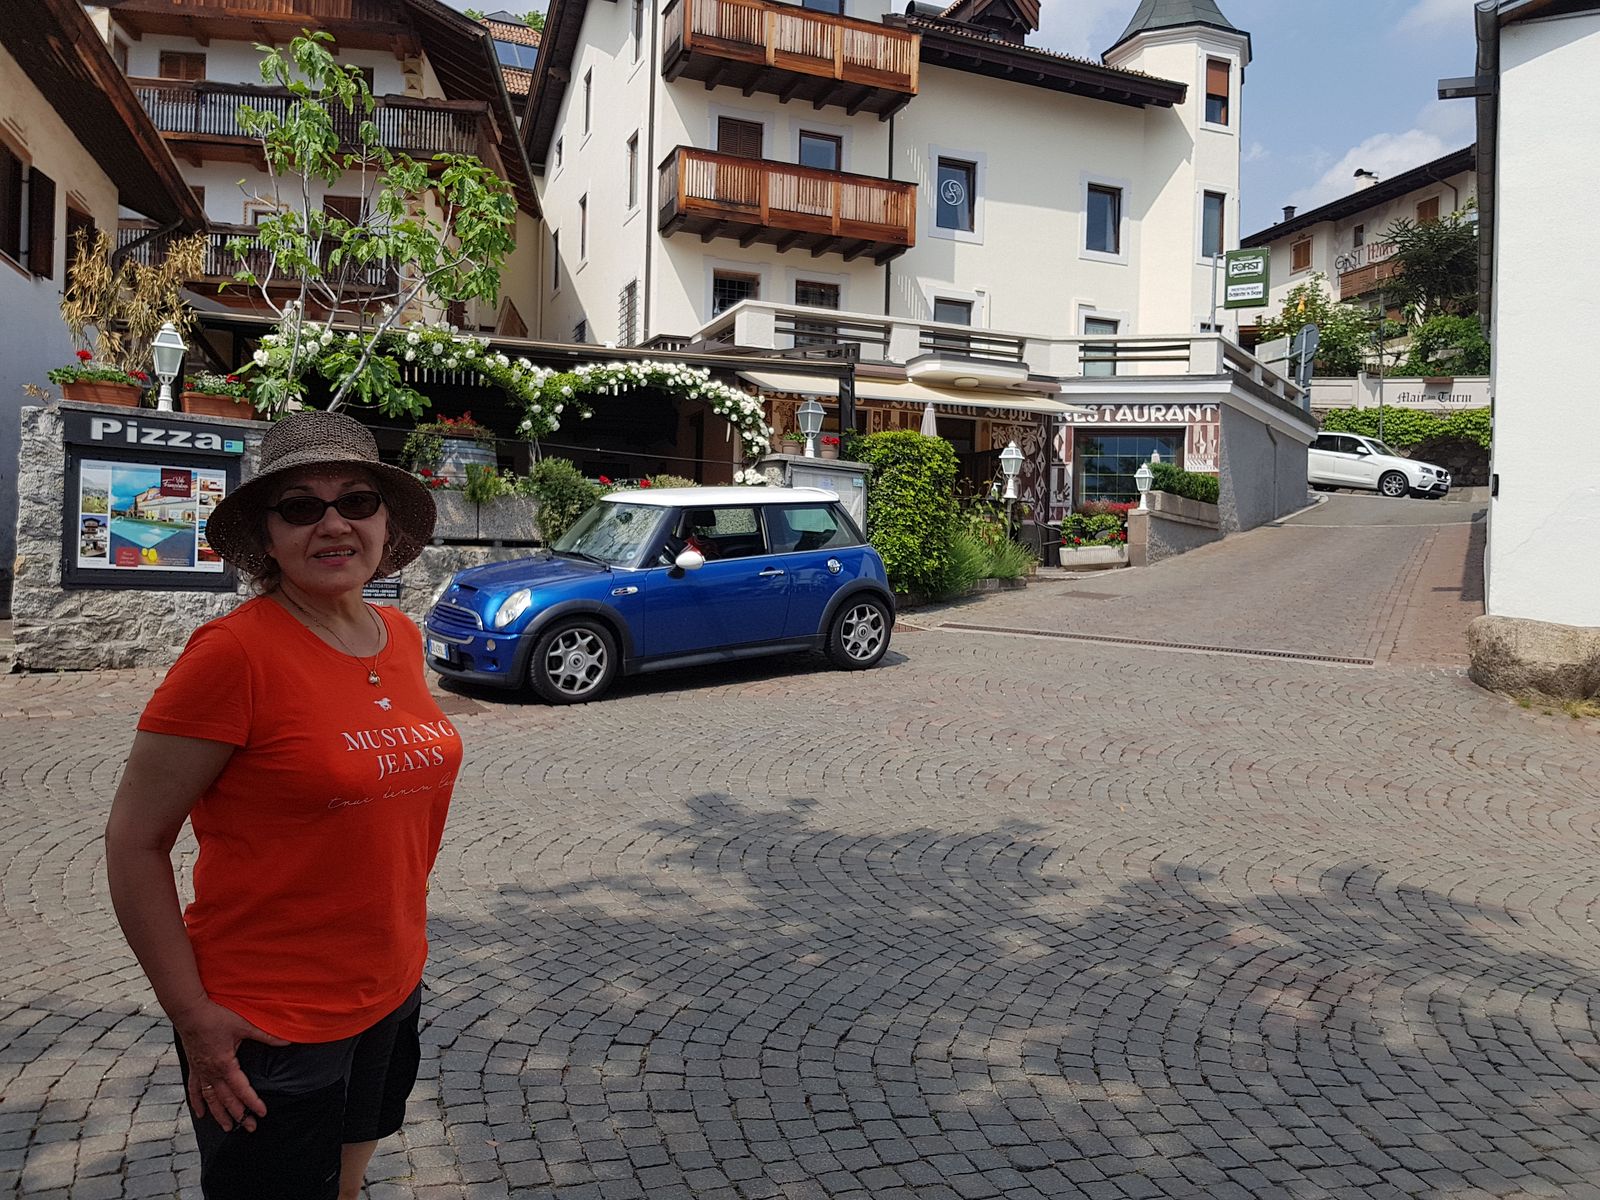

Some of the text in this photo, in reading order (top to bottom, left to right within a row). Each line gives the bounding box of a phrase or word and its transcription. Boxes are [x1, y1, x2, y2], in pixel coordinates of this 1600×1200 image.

[1231, 261, 1261, 272] FORST
[1396, 391, 1426, 403] Mair
[1438, 391, 1472, 403] Turm
[90, 416, 223, 451] Pizza
[340, 719, 455, 751] MUSTANG
[376, 745, 444, 781] JEANS
